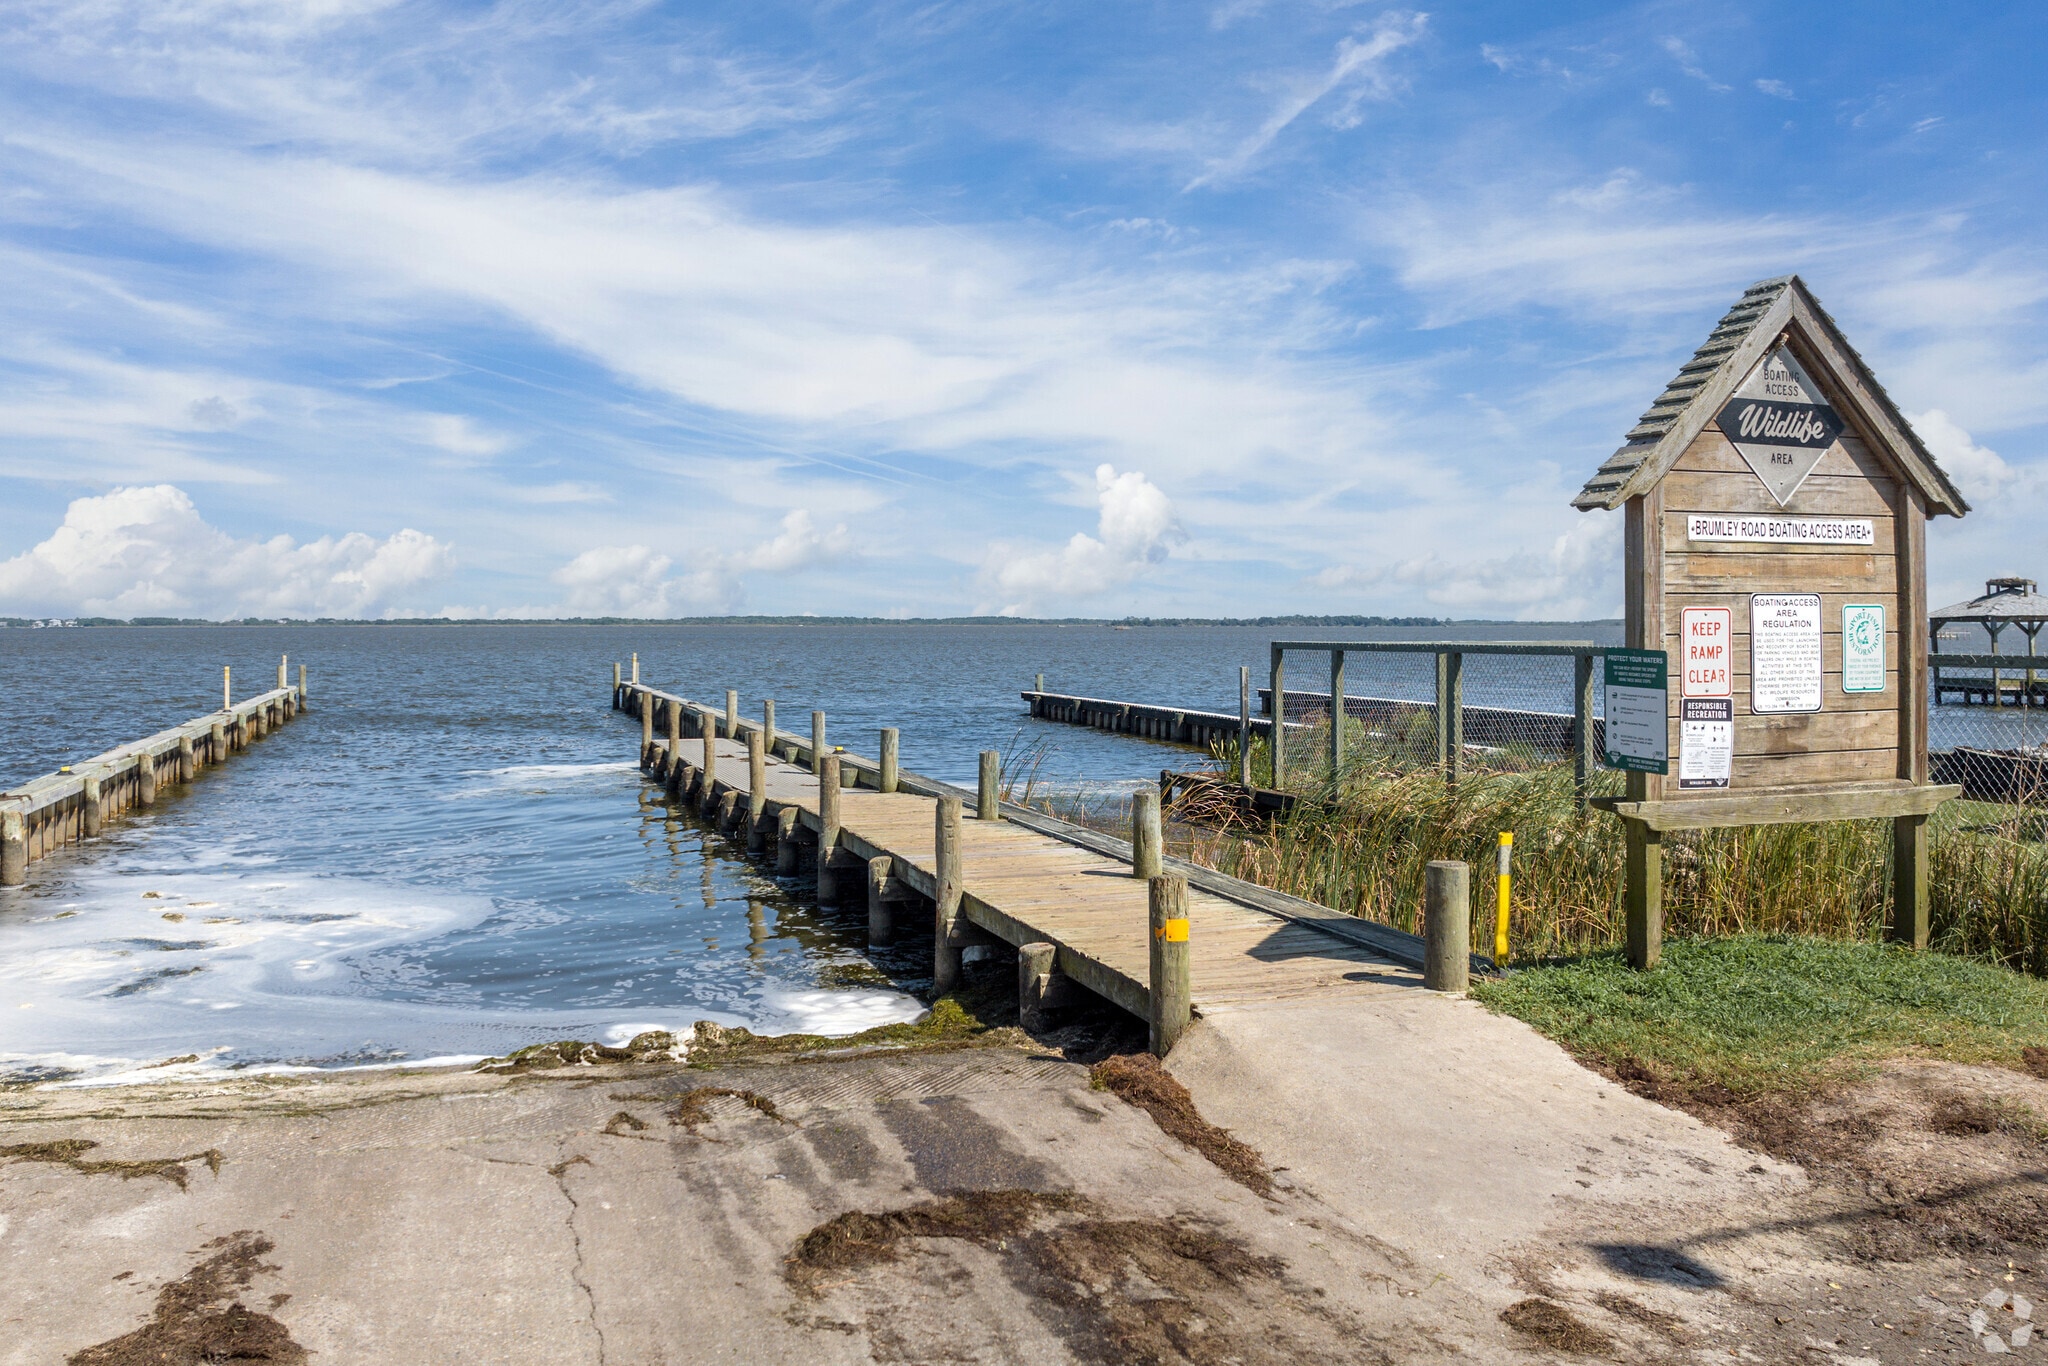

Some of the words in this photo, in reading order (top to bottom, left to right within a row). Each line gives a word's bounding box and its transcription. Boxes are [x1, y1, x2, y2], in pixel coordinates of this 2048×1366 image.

[1764, 369, 1800, 383] BOATING
[1766, 384, 1798, 396] ACCESS
[1738, 404, 1824, 444] Wildlife
[1770, 452, 1793, 464] AREA
[1696, 520, 1739, 536] BRUMLEY
[1742, 521, 1766, 537] ROAD
[1769, 522, 1807, 538] BOATING
[1809, 523, 1842, 539] ACCESS
[1844, 525, 1868, 540] AREA
[1754, 598, 1787, 606] BOATING
[1788, 598, 1818, 606] ACCESS
[1849, 612, 1867, 631] SPORT
[1867, 612, 1880, 631] FISH
[1692, 622, 1720, 636] KEEP
[1848, 632, 1880, 656] RESTORATION
[1690, 646, 1722, 659] RAMP
[1689, 669, 1725, 683] CLEAR
